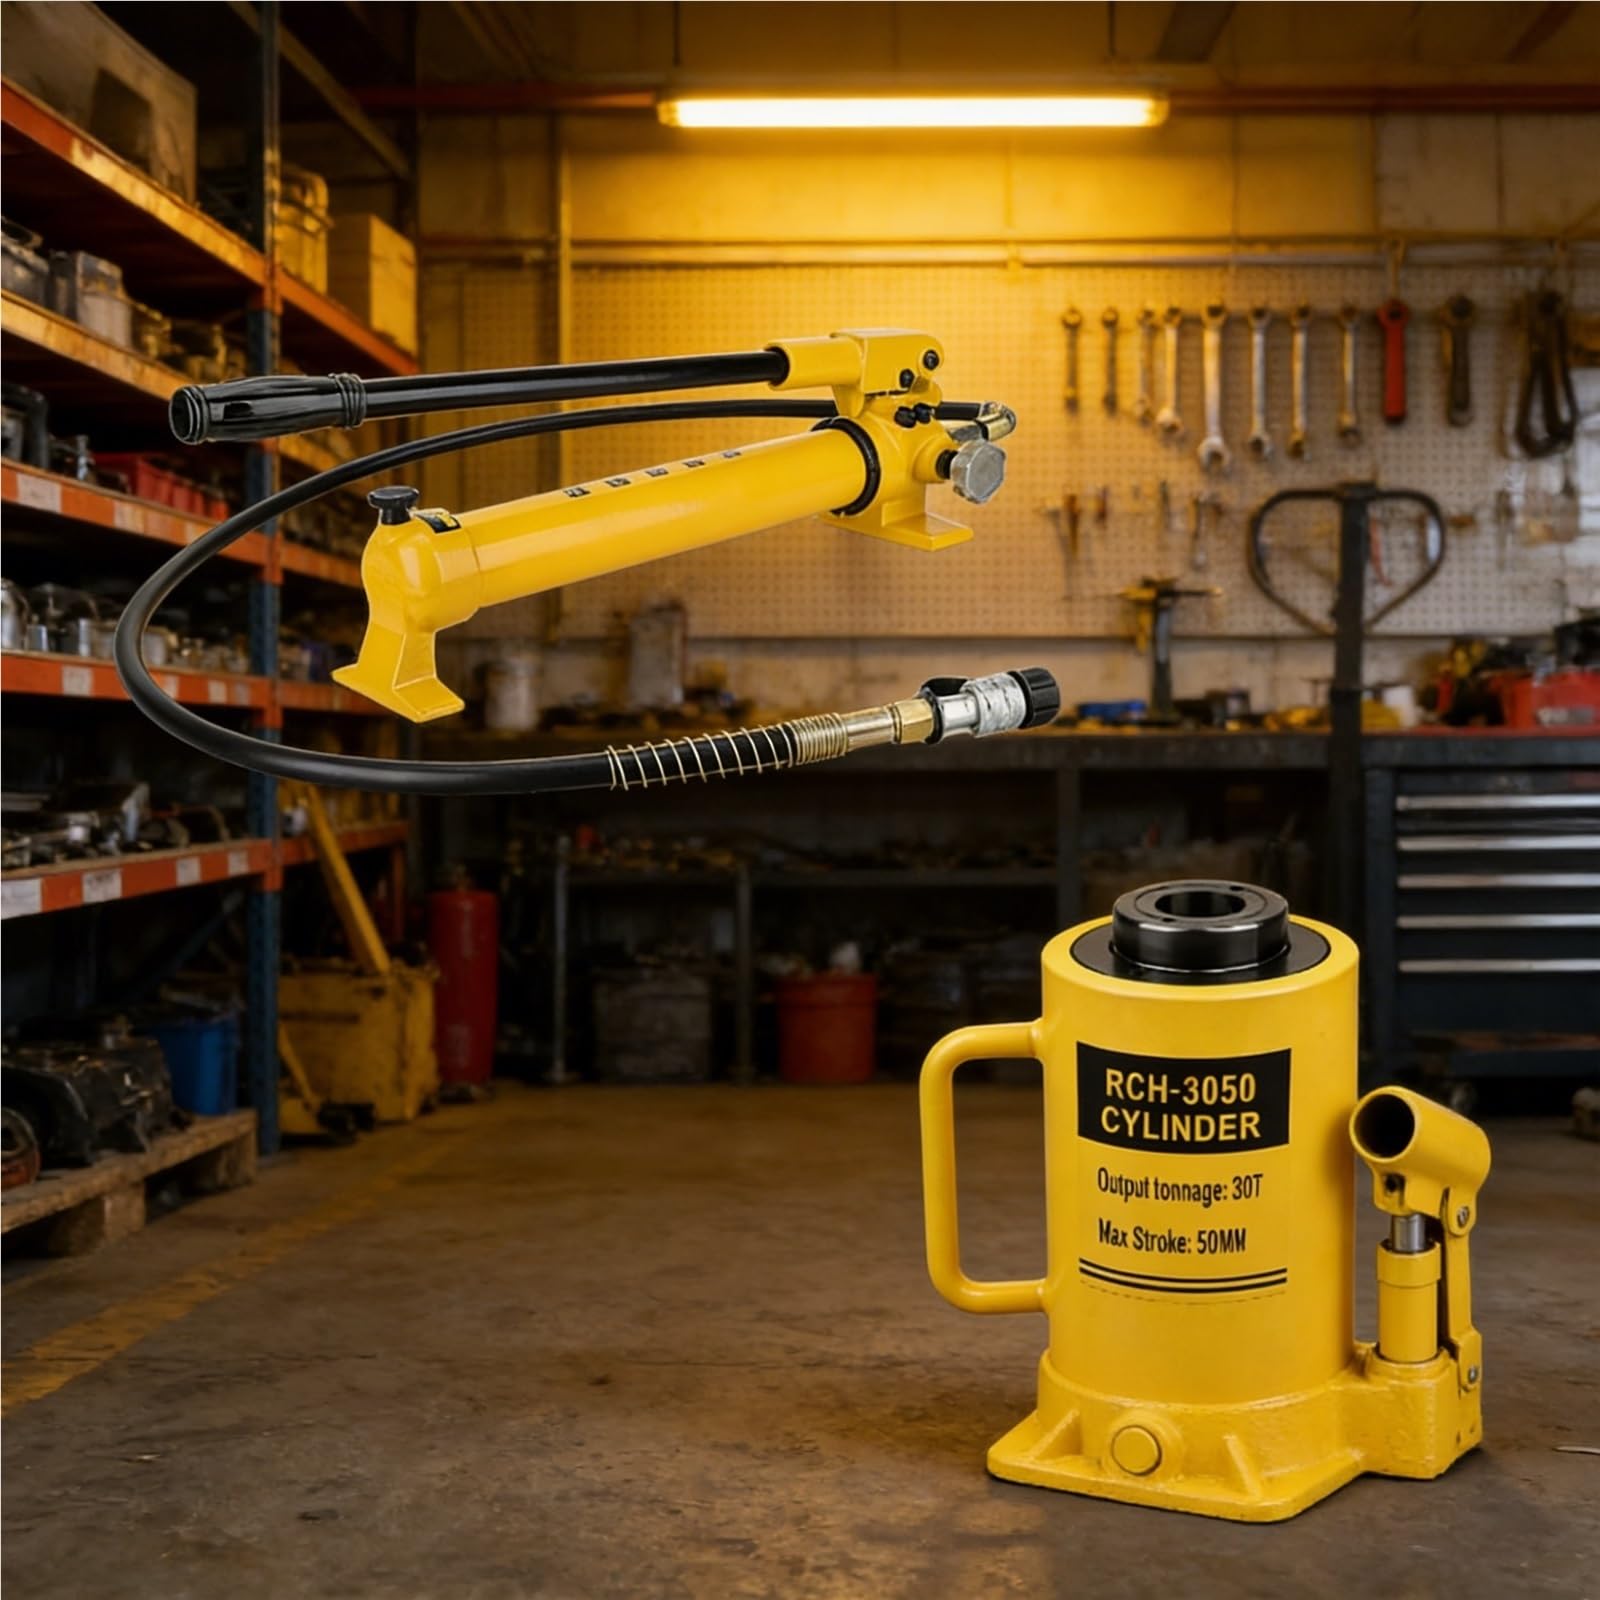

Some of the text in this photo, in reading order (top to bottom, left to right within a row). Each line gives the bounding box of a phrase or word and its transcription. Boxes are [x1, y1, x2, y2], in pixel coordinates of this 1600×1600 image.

[1105, 1068, 1256, 1106] RCH-3050
[1101, 1106, 1262, 1142] CYLINDER
[1097, 1167, 1264, 1209] Output tonnage: 30T
[1098, 1218, 1128, 1249] Max
[1132, 1225, 1192, 1254] Stroke:
